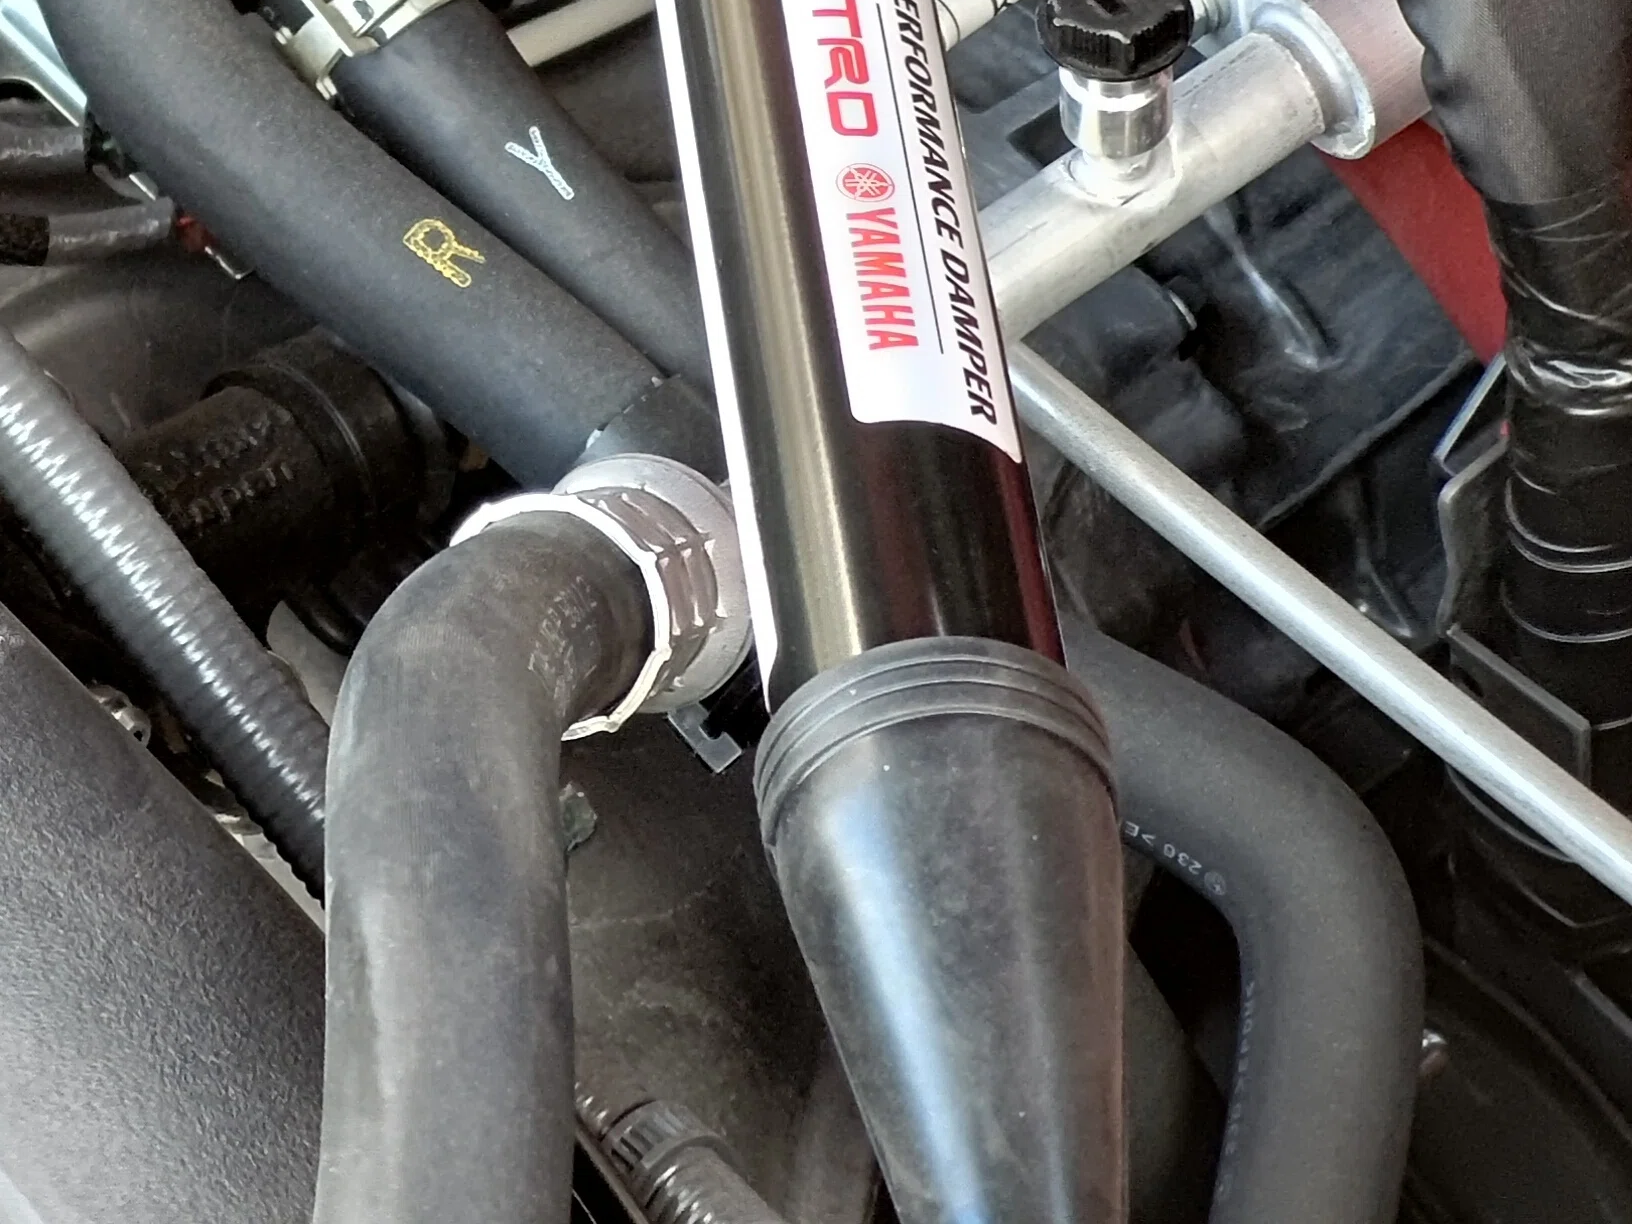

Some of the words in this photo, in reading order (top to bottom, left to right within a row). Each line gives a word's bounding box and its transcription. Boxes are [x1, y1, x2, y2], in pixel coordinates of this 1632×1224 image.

[503, 125, 576, 201] Y
[402, 218, 487, 289] R
[845, 206, 920, 352] YAMAHA
[939, 247, 999, 426] DAMPER
